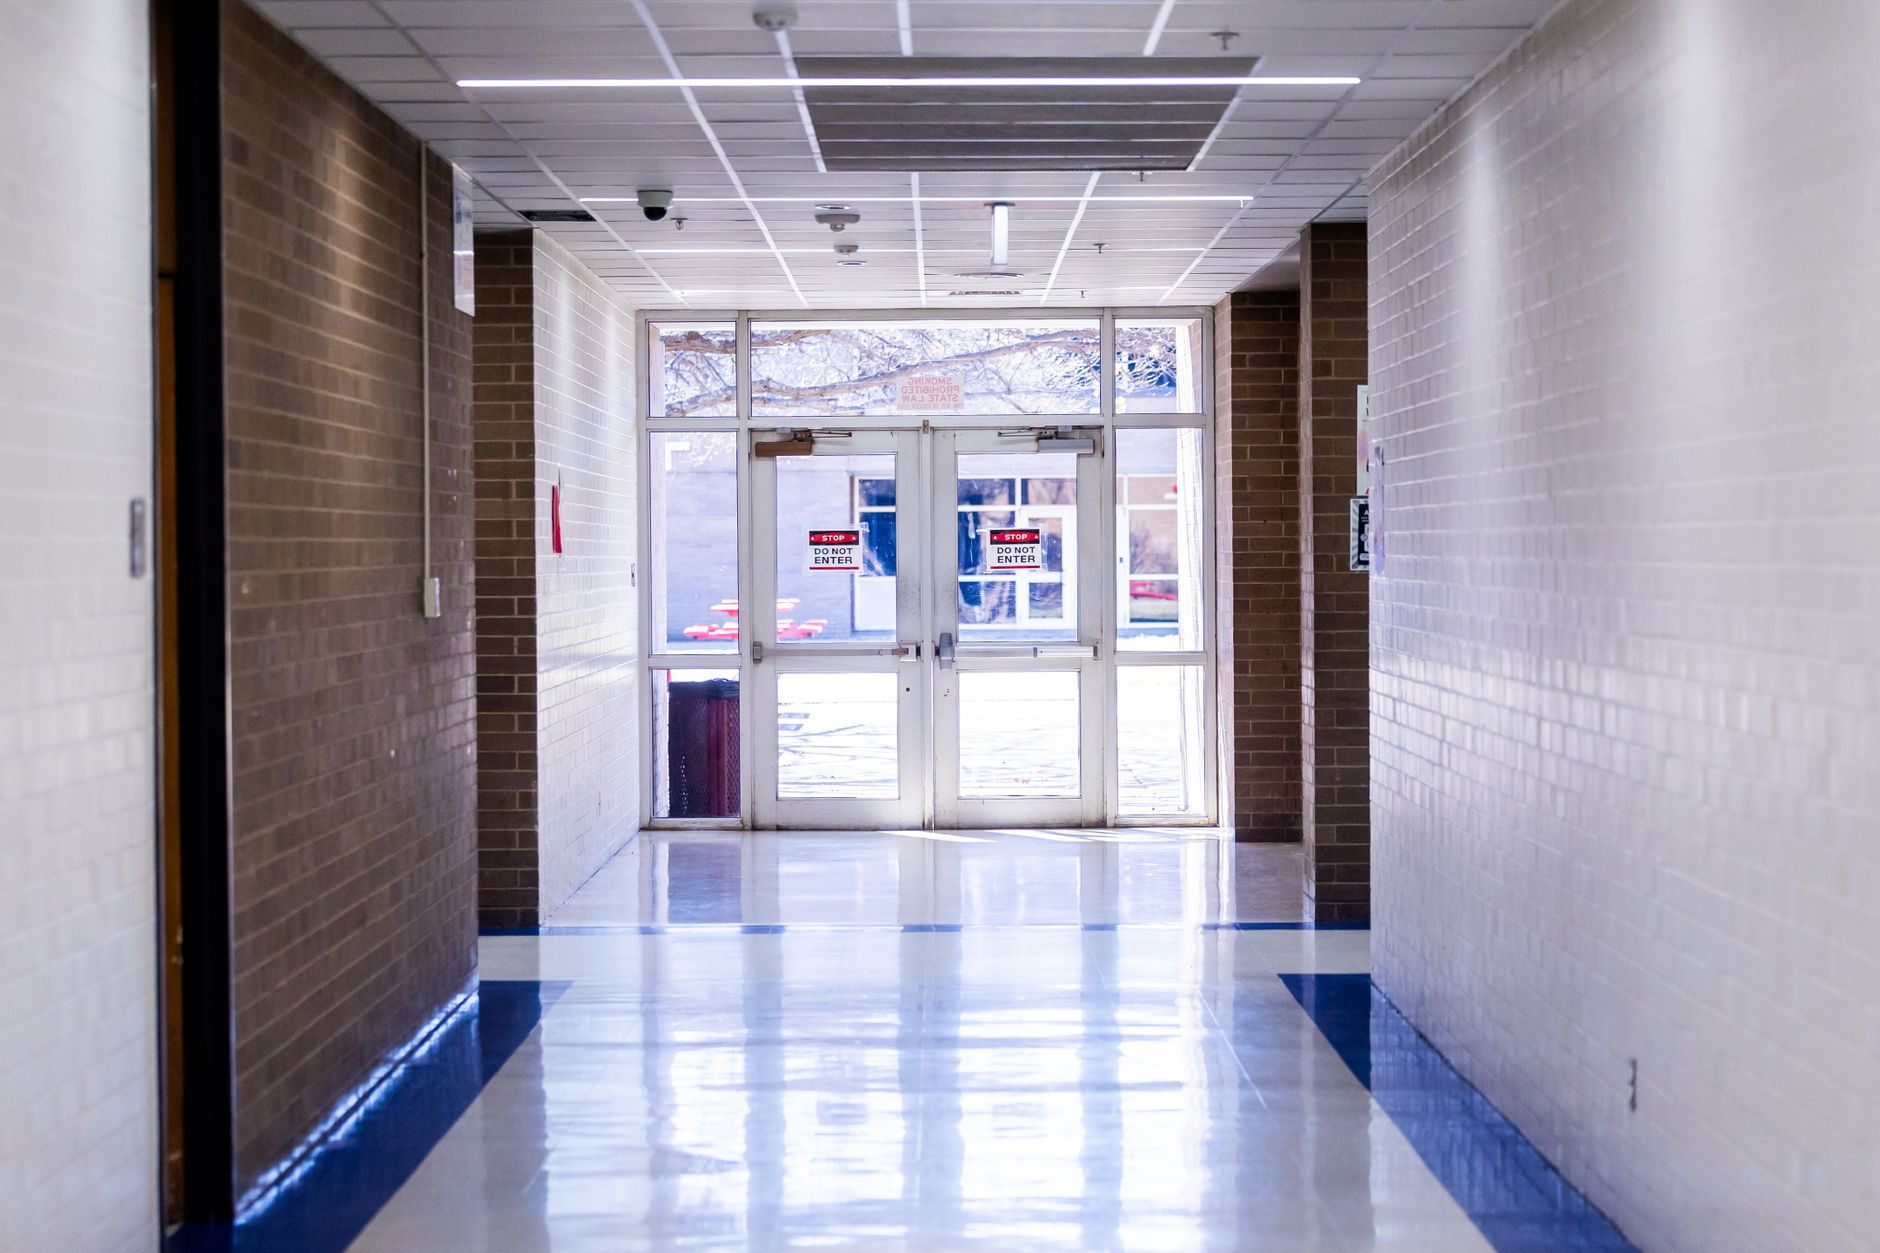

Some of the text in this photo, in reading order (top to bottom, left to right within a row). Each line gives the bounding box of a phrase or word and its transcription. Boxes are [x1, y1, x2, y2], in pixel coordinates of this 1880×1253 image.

[1004, 533, 1028, 541] STOP
[1014, 546, 1036, 554] NOT
[814, 556, 853, 564] ENTER
[997, 555, 1036, 564] ENTER
